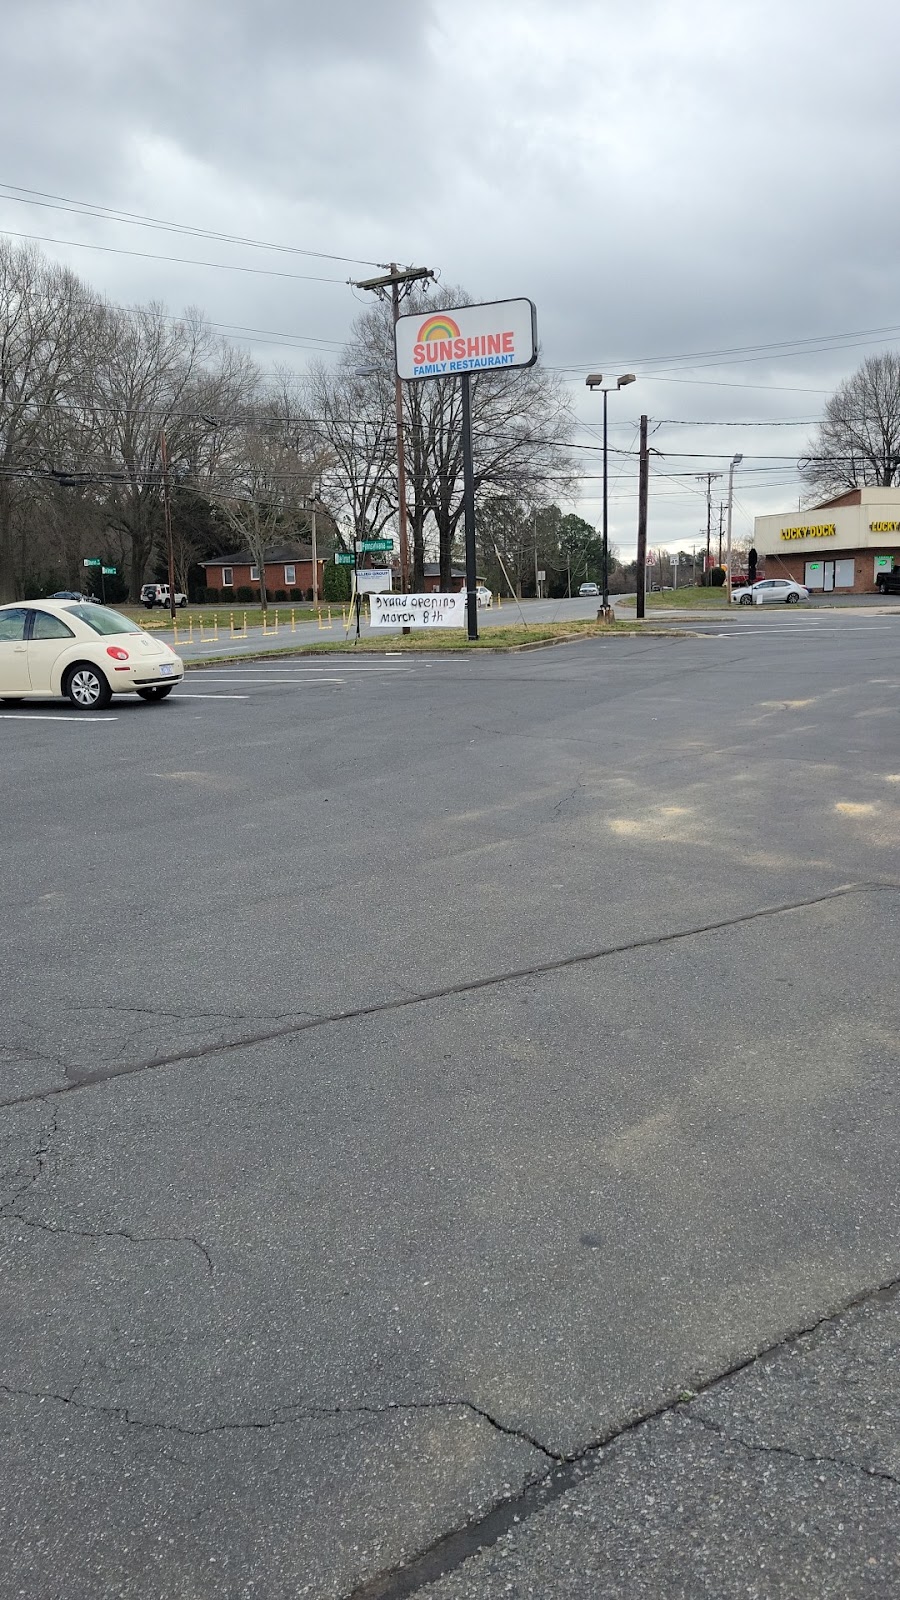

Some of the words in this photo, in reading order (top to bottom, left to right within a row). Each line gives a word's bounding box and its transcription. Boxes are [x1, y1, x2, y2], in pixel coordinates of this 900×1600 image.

[413, 332, 514, 364] SUNSHINE
[413, 362, 446, 375] FAMILY
[450, 354, 514, 371] RESTAURANT
[781, 527, 808, 540] LUCKY
[810, 524, 836, 538] DUCK
[870, 522, 898, 532] LUCKY
[376, 596, 407, 608] grand
[411, 598, 456, 609] opening
[423, 610, 443, 624] 8th
